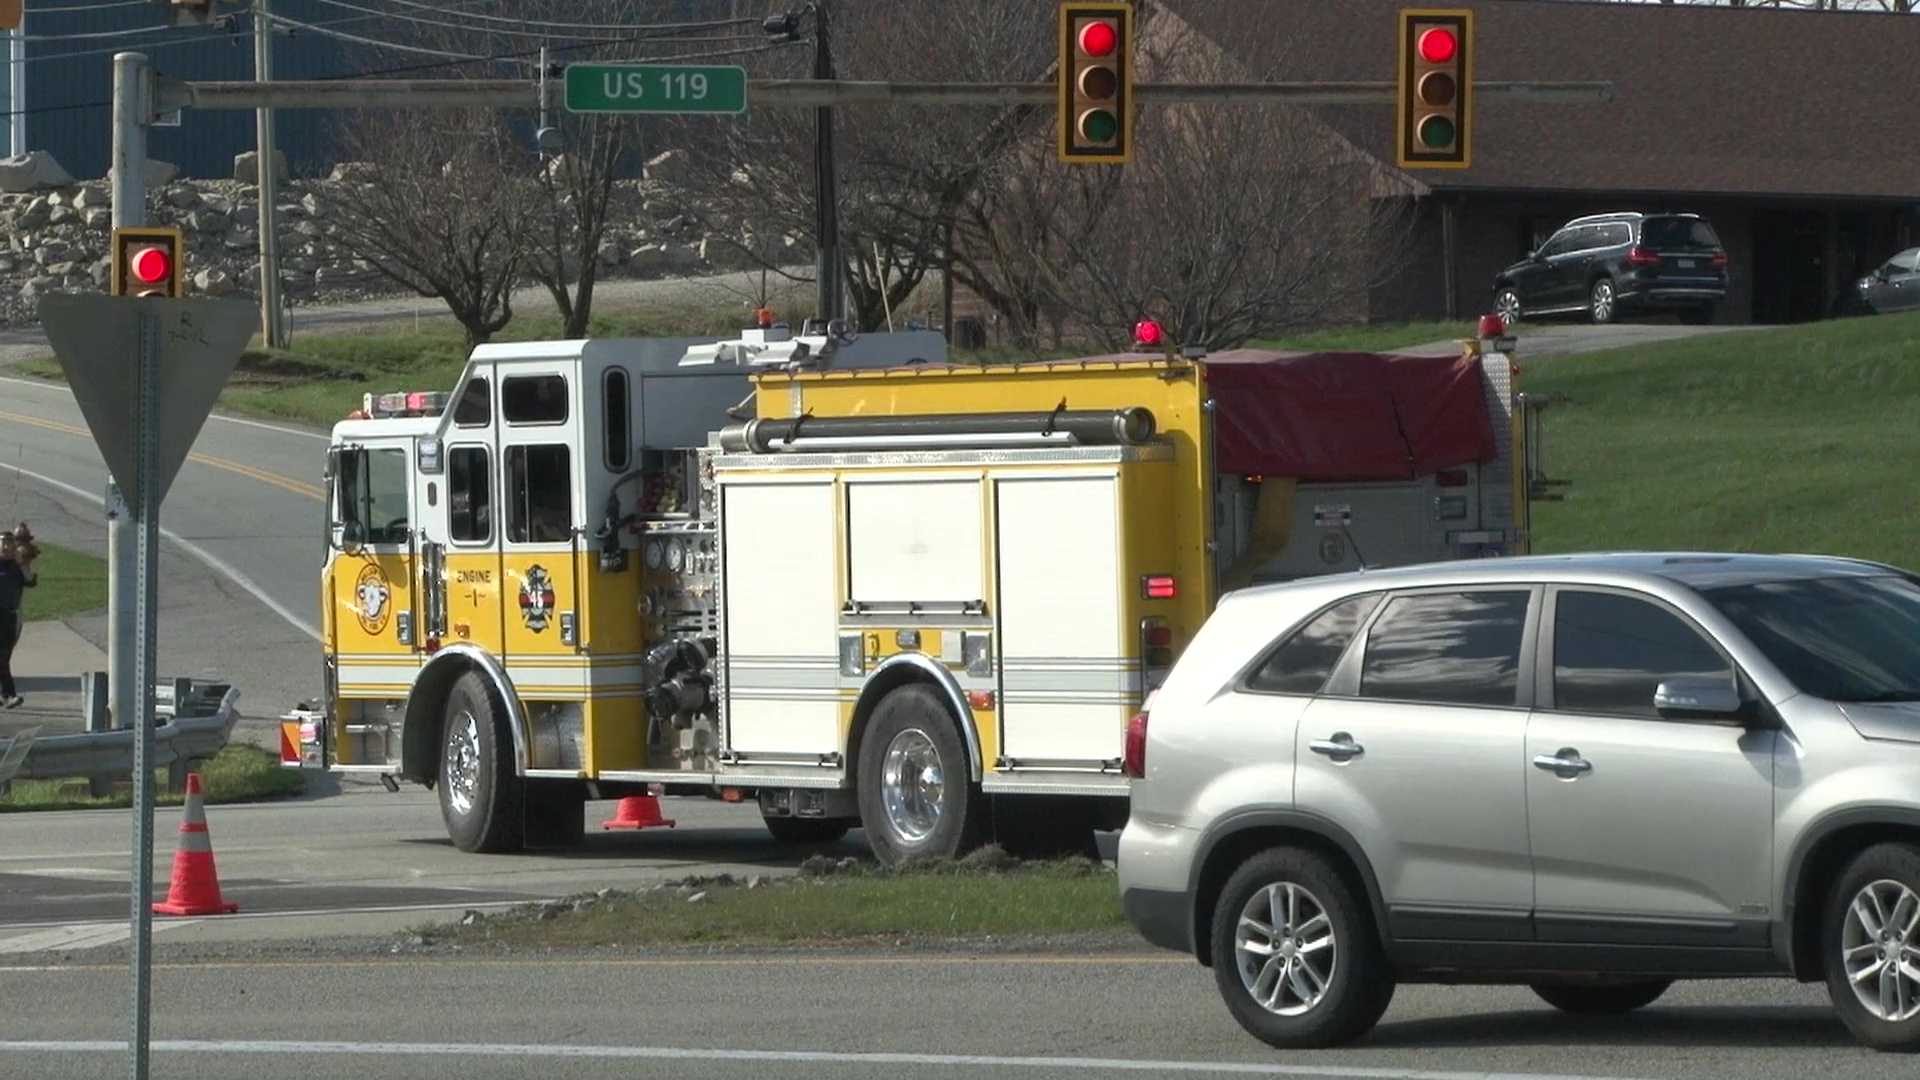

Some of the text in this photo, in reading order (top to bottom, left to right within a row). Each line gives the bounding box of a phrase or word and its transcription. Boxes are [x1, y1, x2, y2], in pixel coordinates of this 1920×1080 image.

[603, 72, 708, 99] US 119
[457, 569, 491, 583] ENGINE
